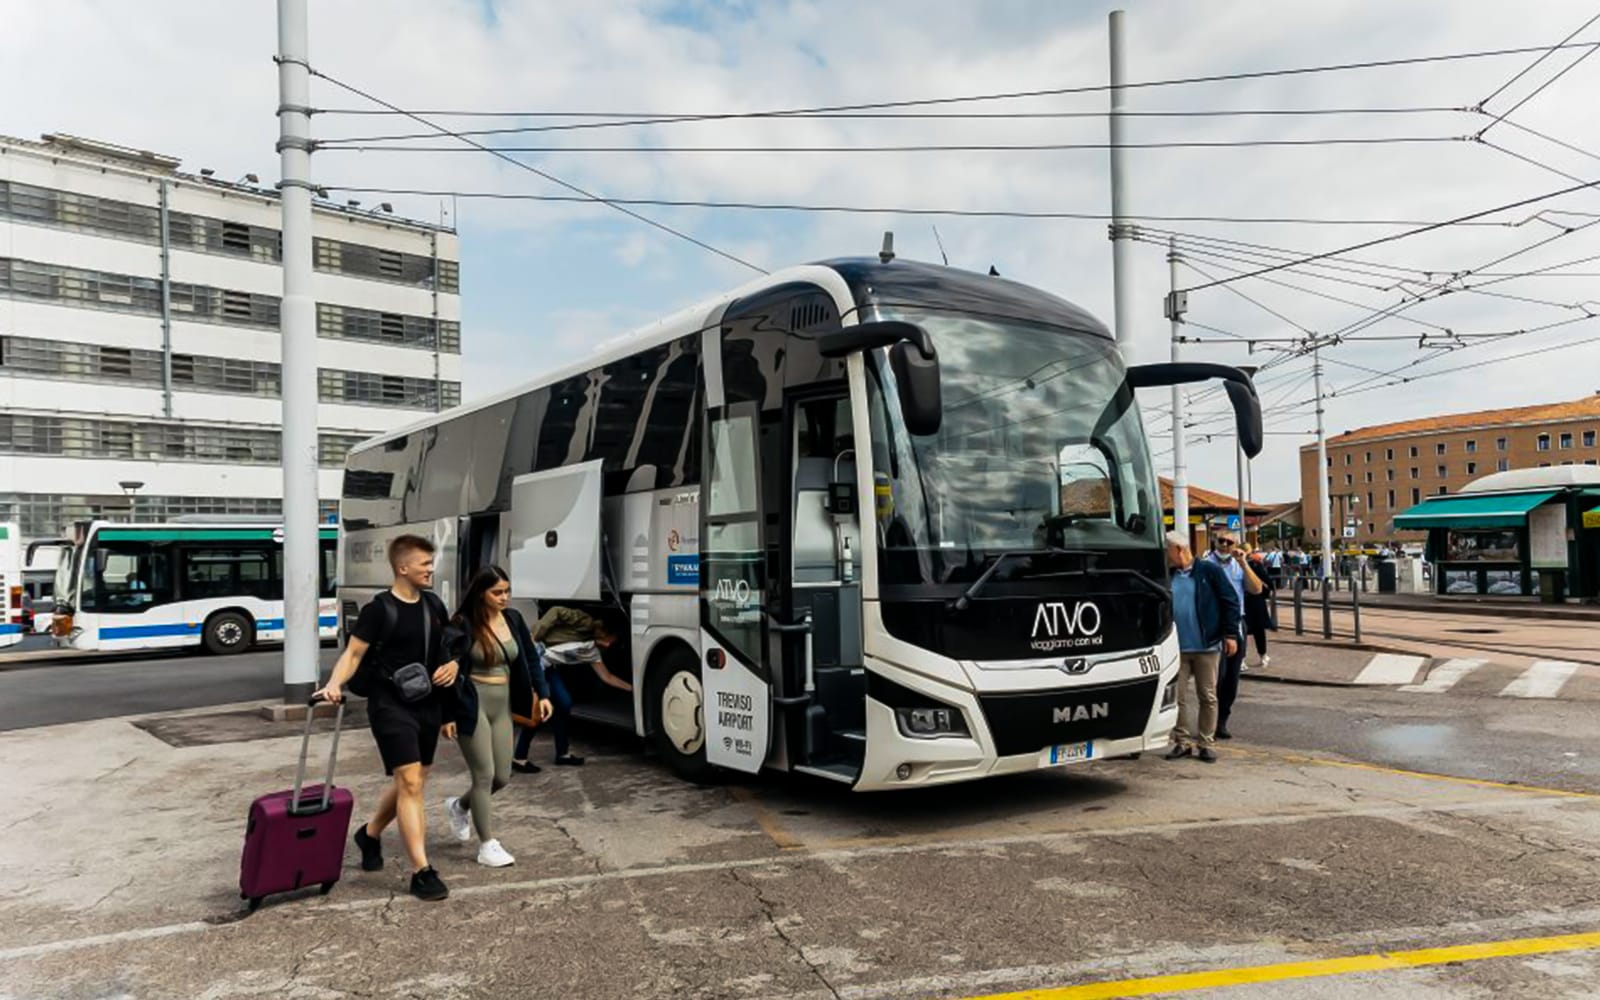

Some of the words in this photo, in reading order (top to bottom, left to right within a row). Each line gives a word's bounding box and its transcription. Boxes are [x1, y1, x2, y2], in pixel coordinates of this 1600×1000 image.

[715, 579, 750, 602] ATVO
[1031, 601, 1101, 637] ATVO
[1030, 638, 1073, 651] viaggiamo
[1074, 637, 1090, 647] con
[1091, 634, 1104, 646] voi
[1138, 655, 1160, 675] 810
[716, 691, 752, 712] TREVISO
[718, 711, 753, 731] AIRPORT
[1053, 702, 1109, 723] MAN
